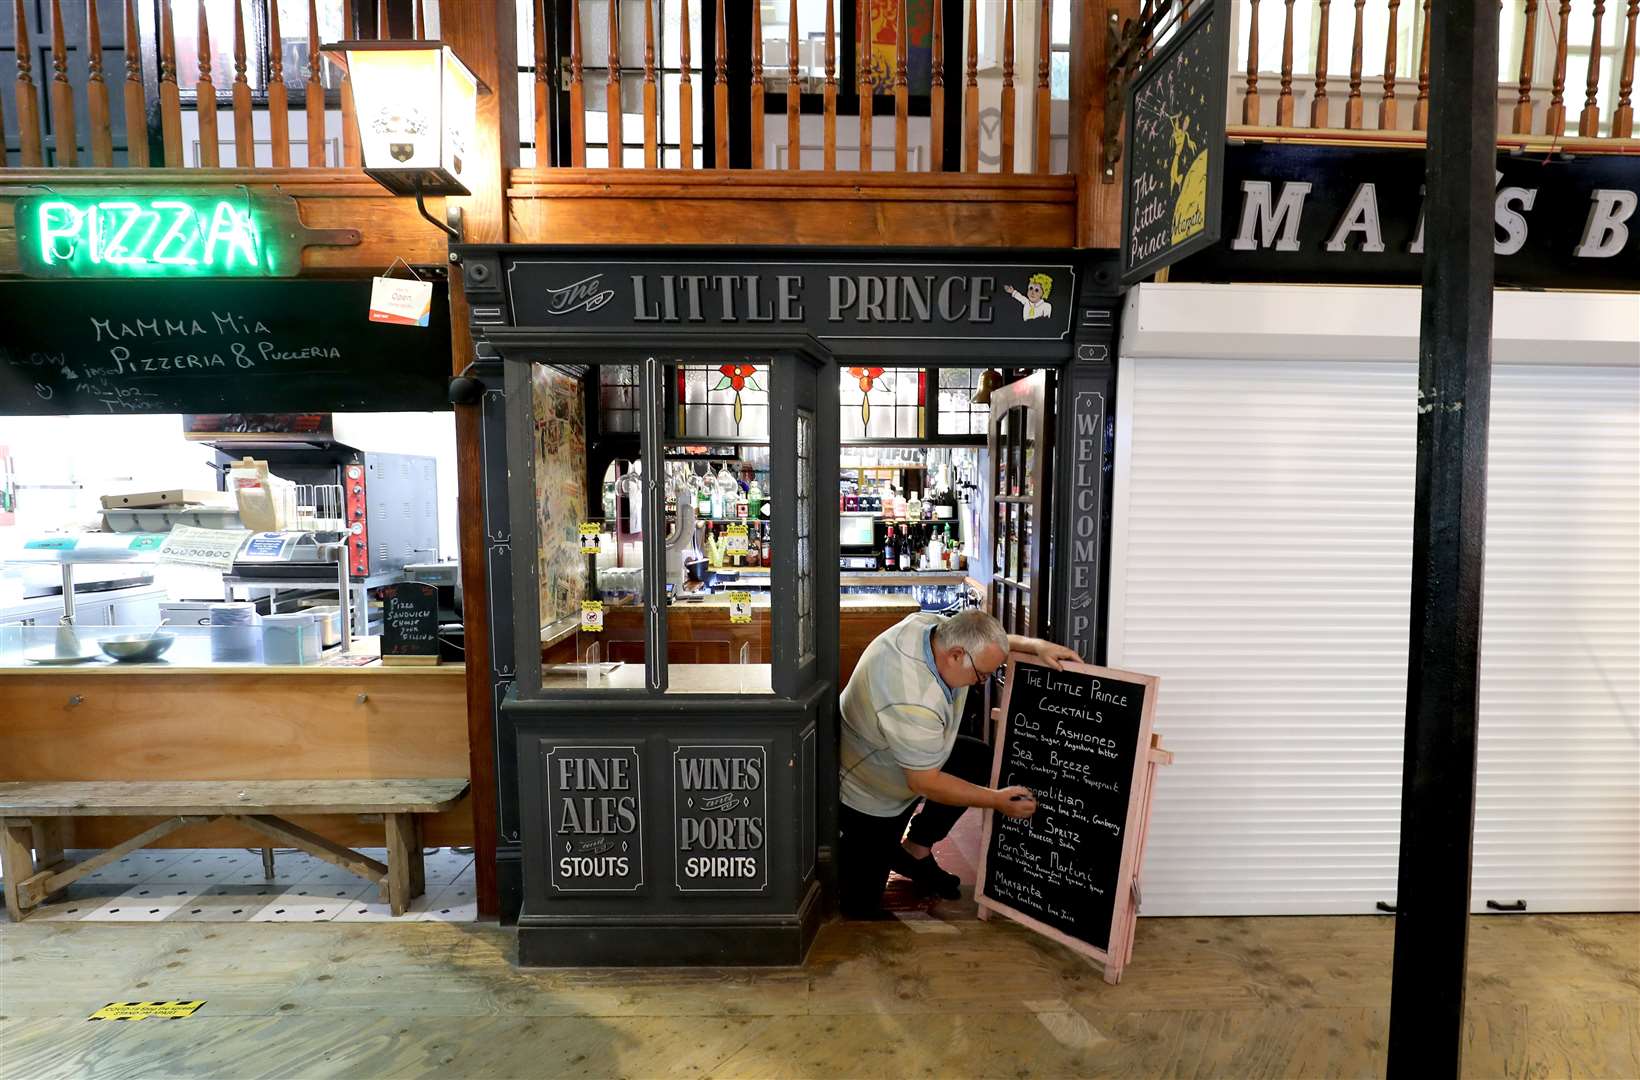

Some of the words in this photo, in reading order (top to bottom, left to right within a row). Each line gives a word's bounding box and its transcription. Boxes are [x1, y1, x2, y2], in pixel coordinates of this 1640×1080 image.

[1133, 171, 1157, 204] The
[1132, 196, 1165, 236] Little
[1230, 170, 1538, 256] MA'S
[38, 200, 260, 266] PIZZA
[1130, 229, 1166, 267] Prince
[630, 275, 803, 322] LITTLE
[828, 275, 995, 322] PRINCE
[91, 316, 207, 342] MAMMA
[110, 346, 226, 374] PIZZERIA
[231, 342, 256, 369] &
[840, 448, 921, 463] EAUTIFUL
[1074, 414, 1100, 588] WELCOME
[1072, 616, 1089, 661] PU
[1046, 671, 1083, 697] LITTLE
[557, 758, 630, 790] FINE
[678, 757, 762, 791] WINES
[1011, 741, 1034, 761] Sea
[1049, 750, 1091, 775] Breeze
[557, 796, 636, 834] ALES
[680, 816, 764, 851] PORTS
[559, 856, 630, 878] STOUTS
[684, 856, 757, 878] SPIRITS
